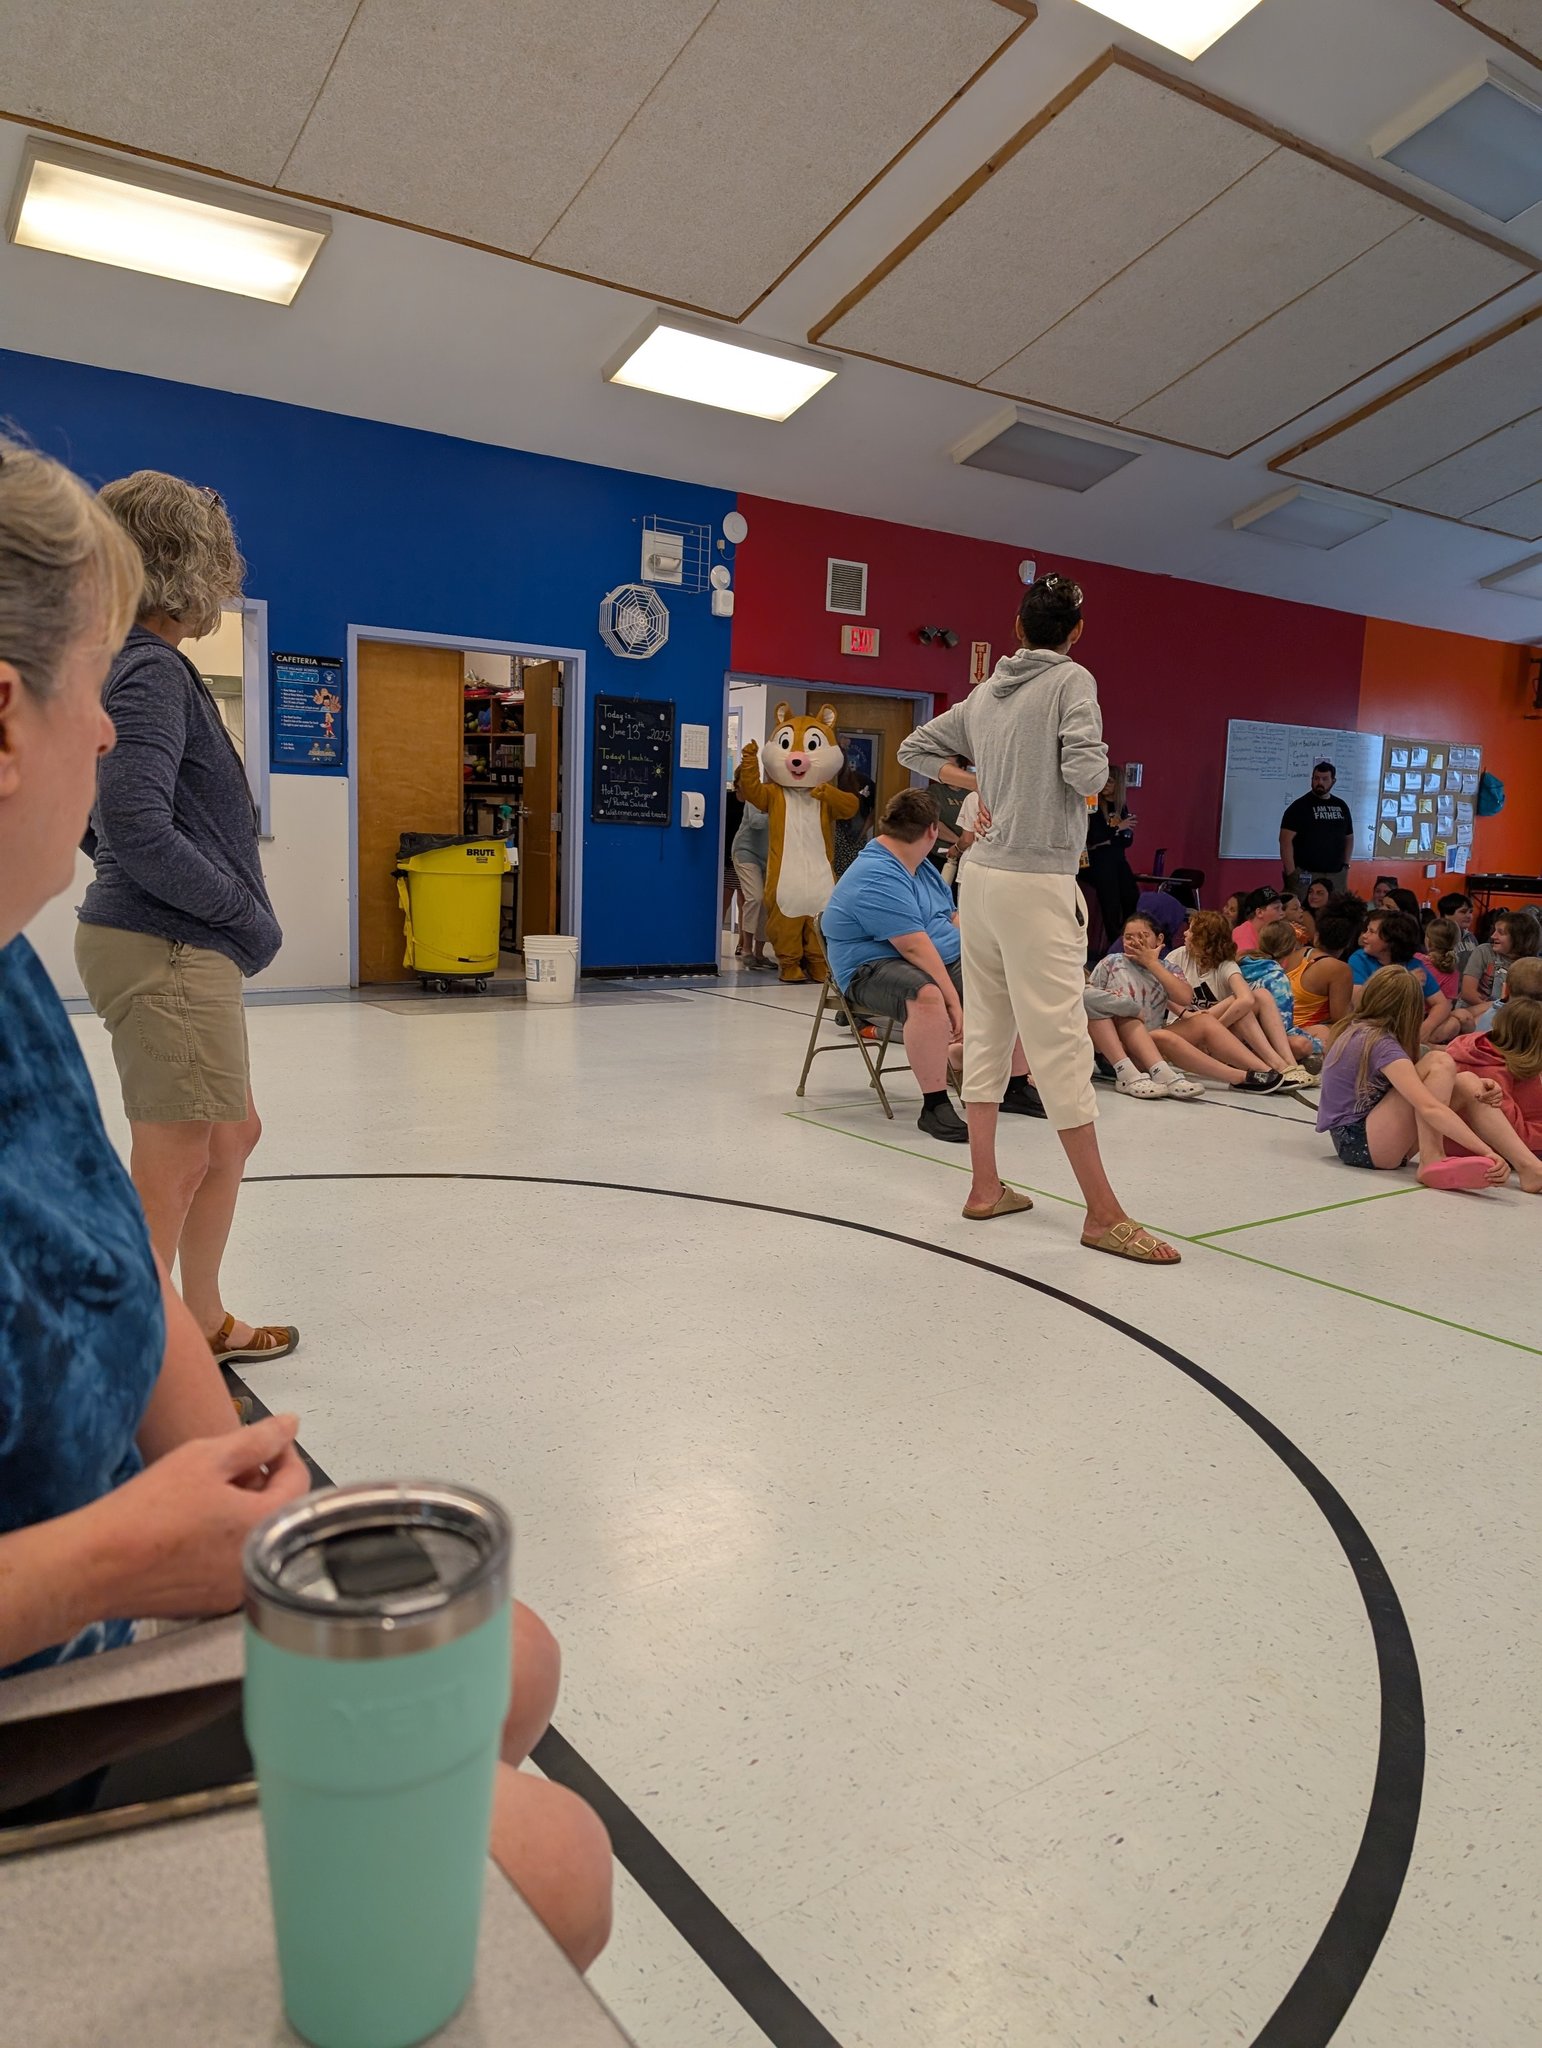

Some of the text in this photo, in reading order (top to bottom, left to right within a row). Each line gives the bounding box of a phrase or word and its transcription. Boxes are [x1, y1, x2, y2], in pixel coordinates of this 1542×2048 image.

[851, 628, 874, 653] EXIT
[276, 655, 318, 665] CAFETERIA
[599, 704, 624, 723] Today
[609, 723, 626, 739] June
[466, 848, 495, 856] BRUTE
